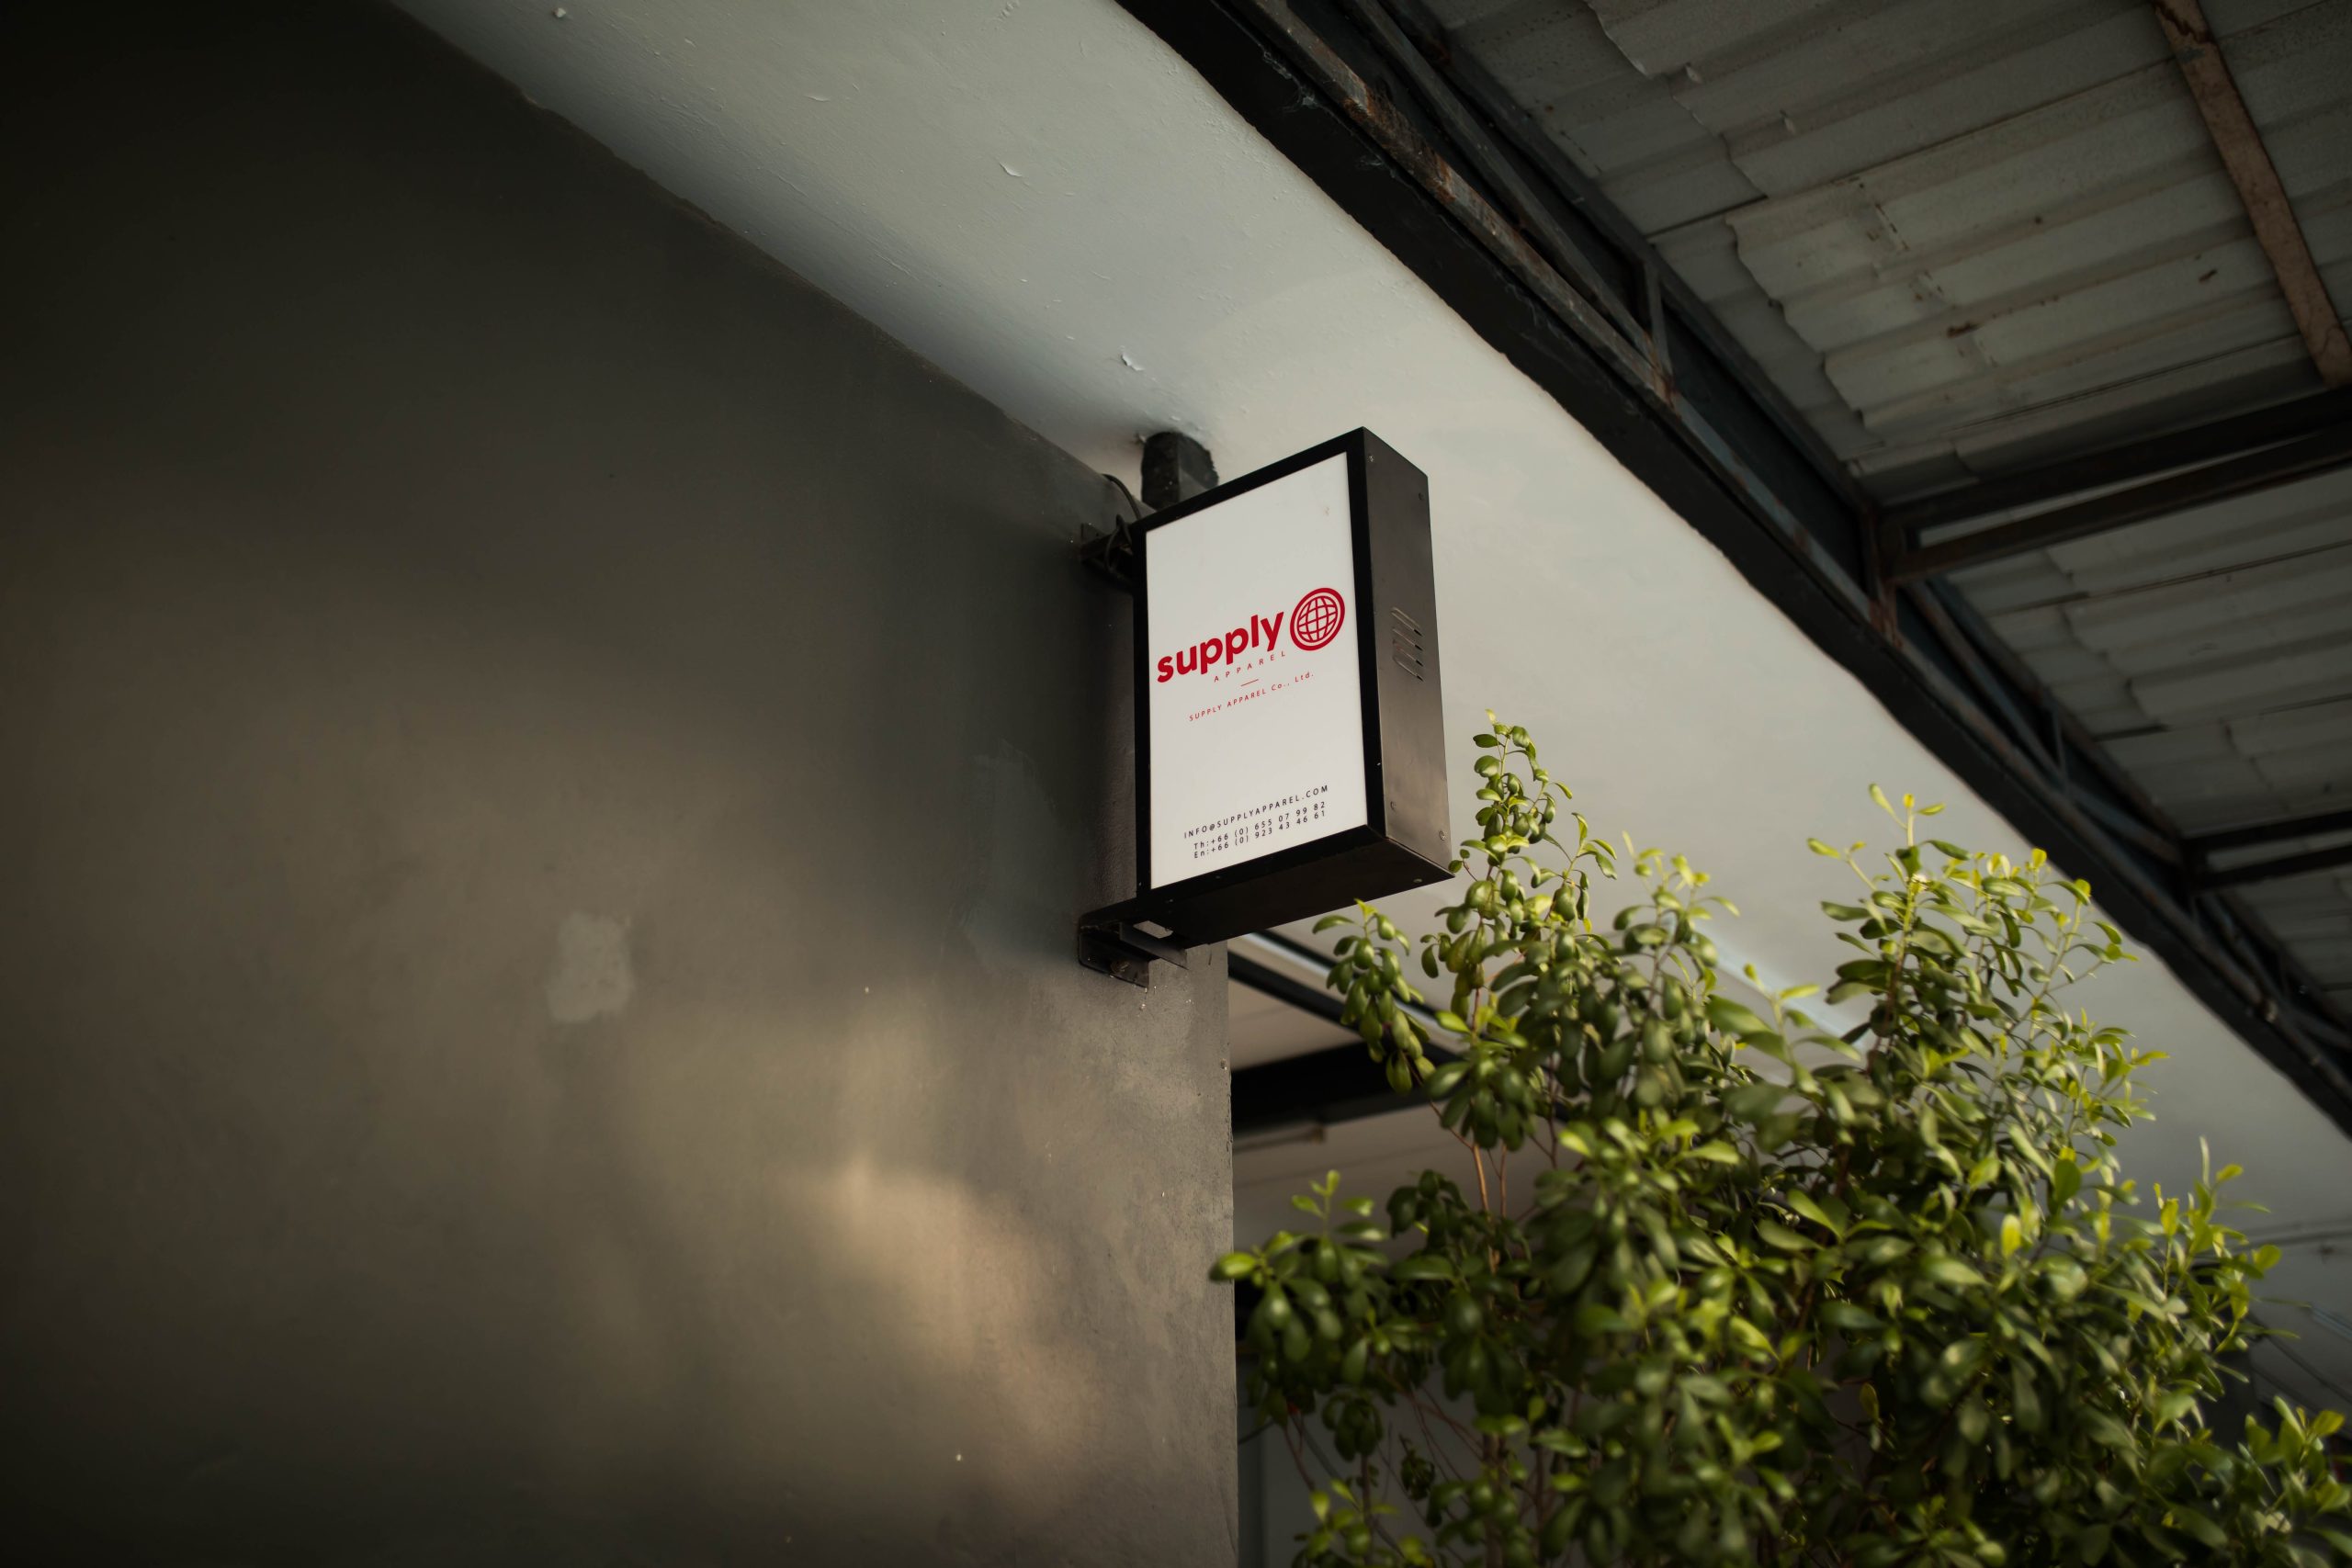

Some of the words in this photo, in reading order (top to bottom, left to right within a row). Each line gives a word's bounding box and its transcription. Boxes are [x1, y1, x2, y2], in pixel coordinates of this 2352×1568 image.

[1157, 611, 1284, 683] supply
[1214, 650, 1286, 683] APPAREL
[1189, 705, 1223, 722] SUPPLY
[1227, 688, 1267, 707] APPAREL
[1271, 682, 1290, 692] Co.,
[1295, 671, 1314, 682] Ltd.
[1183, 784, 1329, 840] INFO@SUPPLYAPPAREL.COM
[1193, 834, 1228, 851] Th:+66
[1234, 827, 1249, 838] (0)
[1254, 819, 1272, 830] 655
[1278, 813, 1290, 822] 07
[1295, 807, 1307, 817] 99
[1313, 801, 1326, 811] 82
[1193, 842, 1229, 859] En:+66
[1234, 836, 1249, 846] (0)
[1254, 828, 1272, 839] 923
[1278, 821, 1290, 830] 43
[1296, 817, 1308, 825] 46
[1314, 810, 1326, 820] 61
